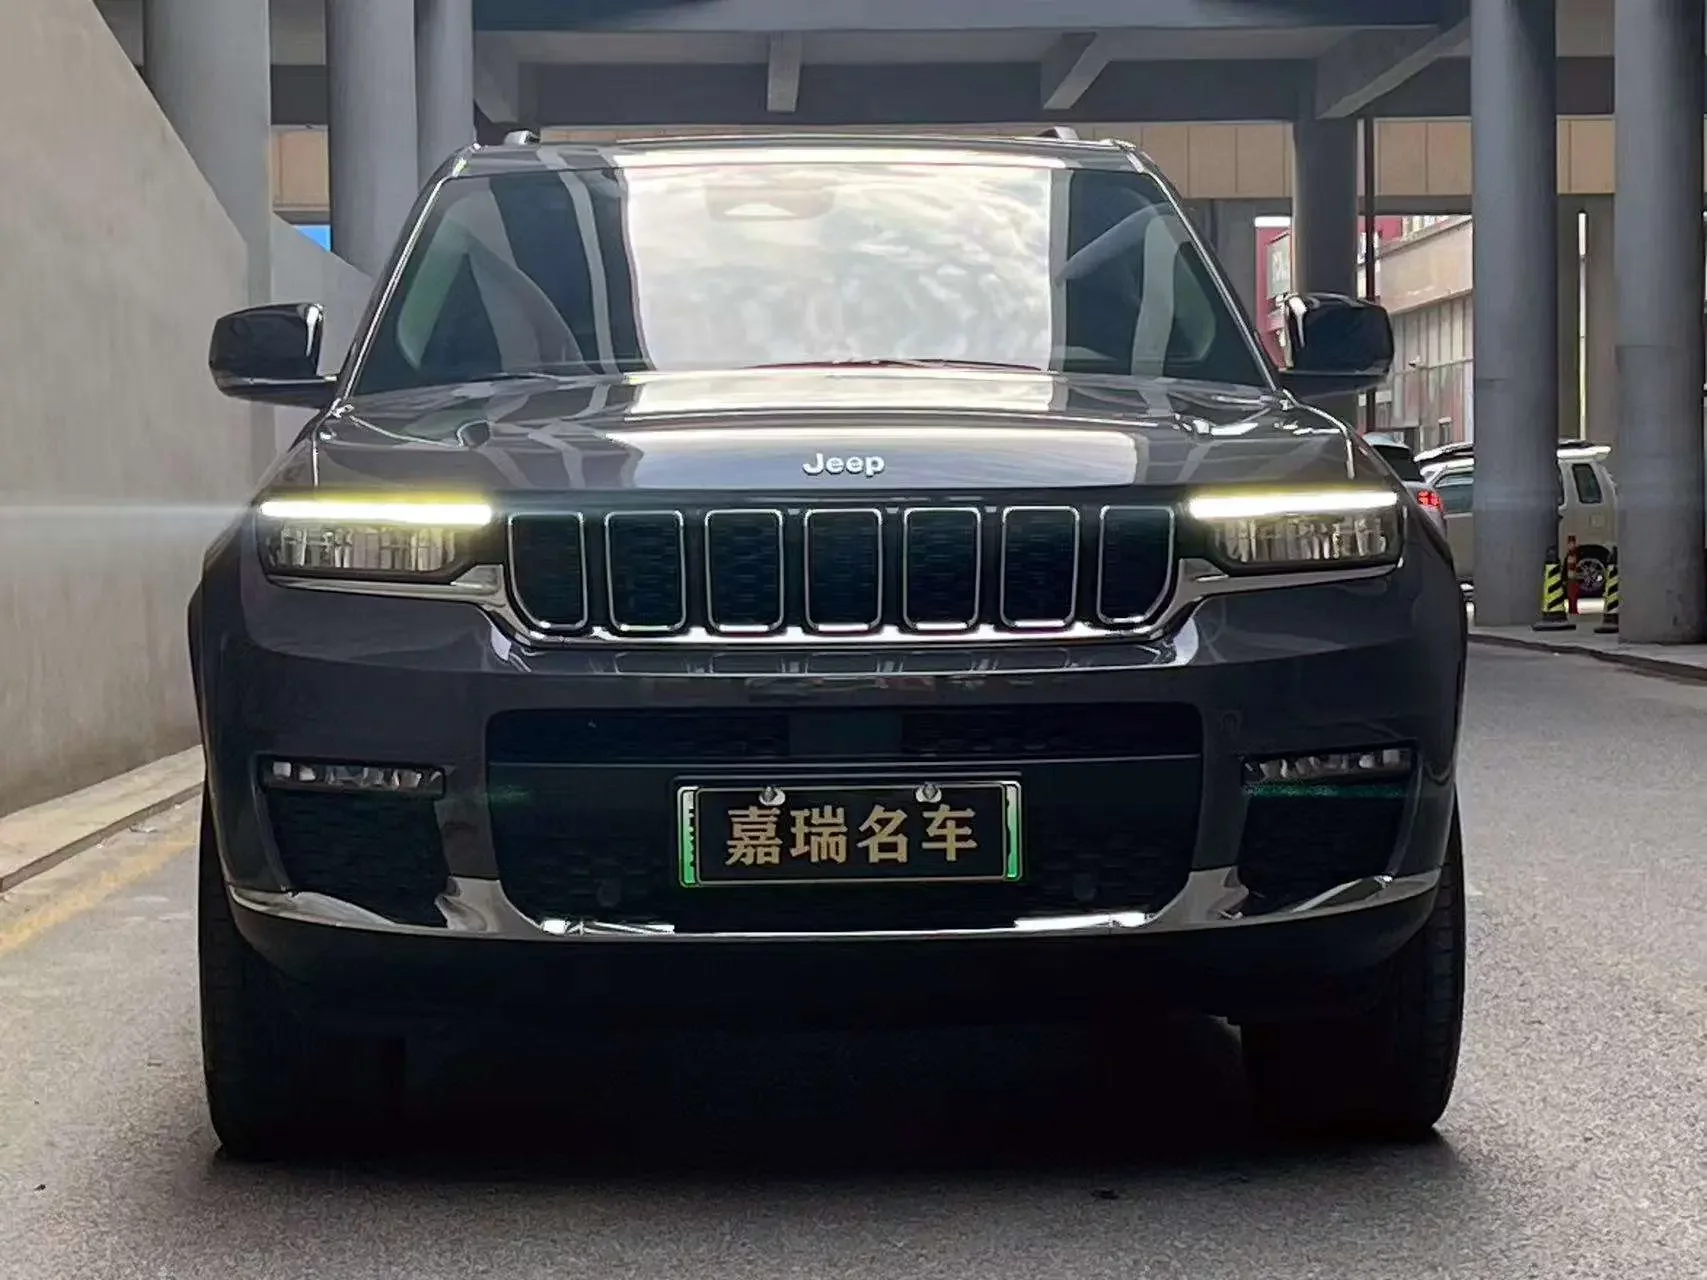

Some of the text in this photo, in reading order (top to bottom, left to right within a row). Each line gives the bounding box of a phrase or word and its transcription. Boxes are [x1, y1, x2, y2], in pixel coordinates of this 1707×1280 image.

[802, 453, 885, 477] Jeep
[725, 804, 978, 866] 嘉瑞名车
